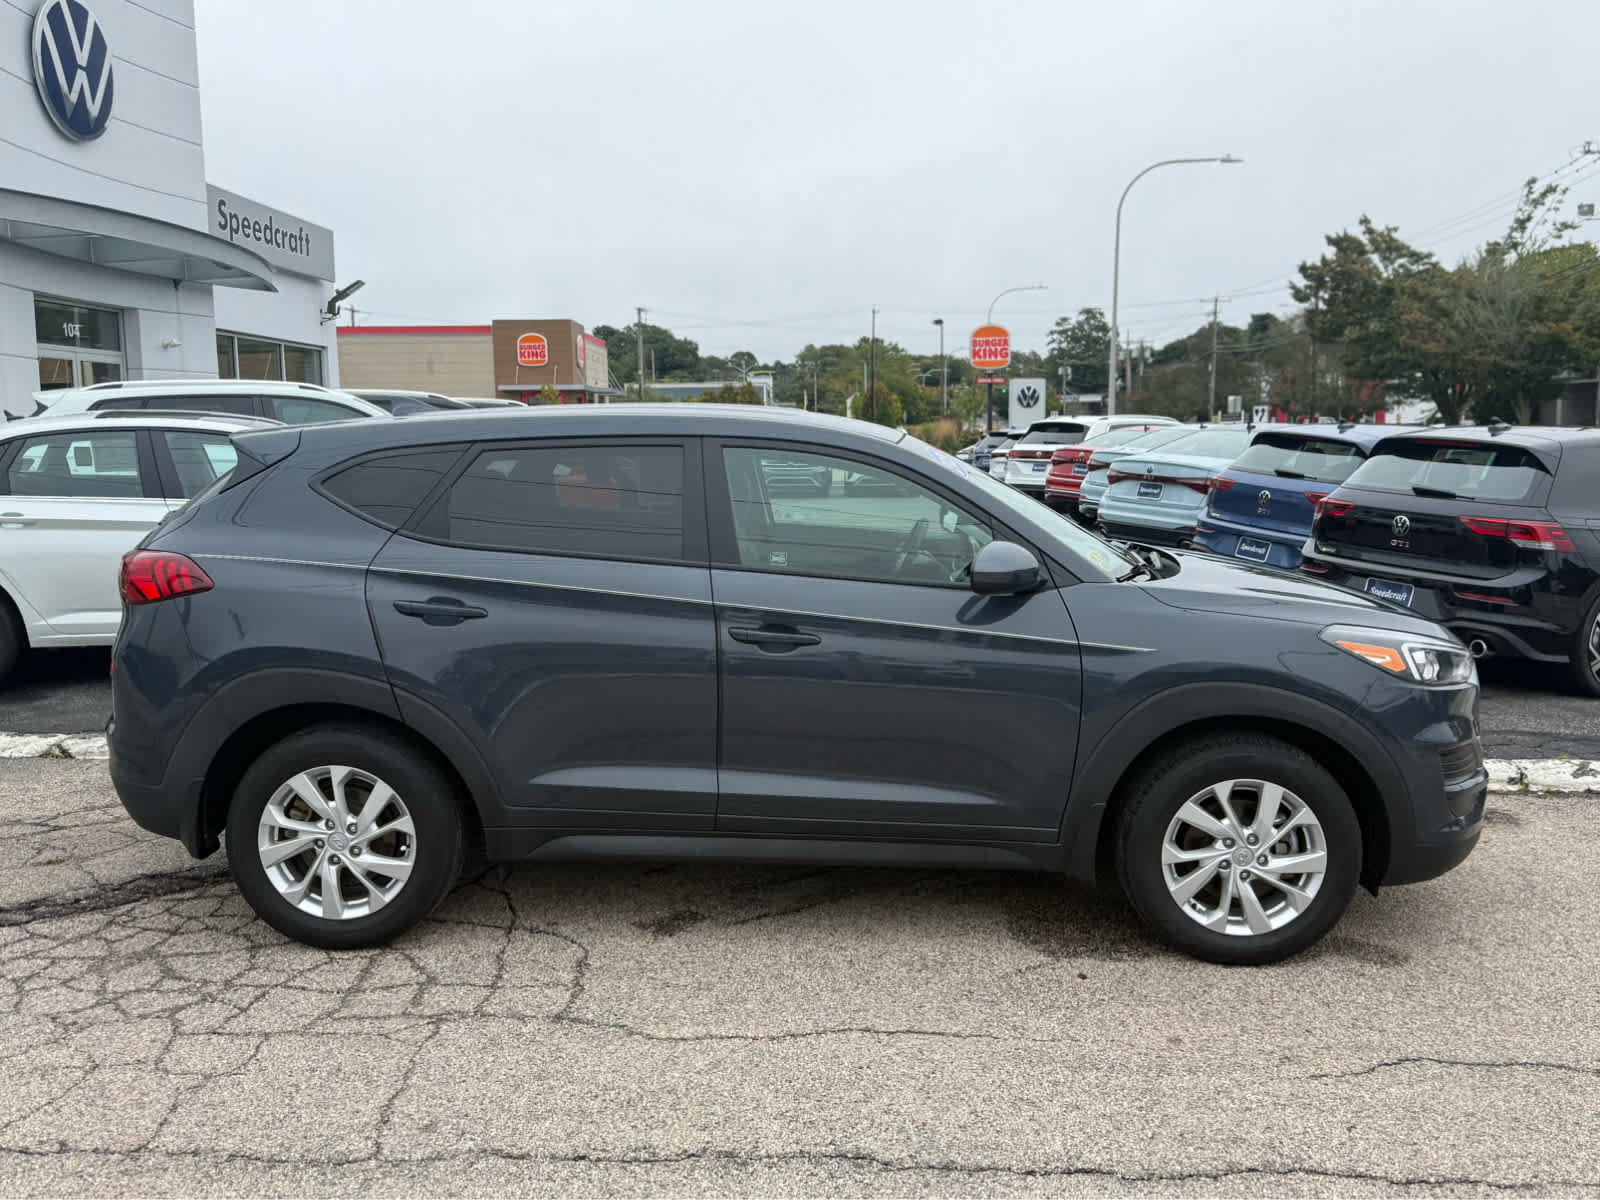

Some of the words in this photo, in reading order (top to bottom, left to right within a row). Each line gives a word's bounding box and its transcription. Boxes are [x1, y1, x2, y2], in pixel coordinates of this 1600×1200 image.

[217, 198, 310, 257] Speedcraft
[971, 338, 1009, 347] BURGER
[519, 350, 546, 360] KING
[972, 347, 1009, 359] KING
[1370, 586, 1408, 602] Speedcraft
